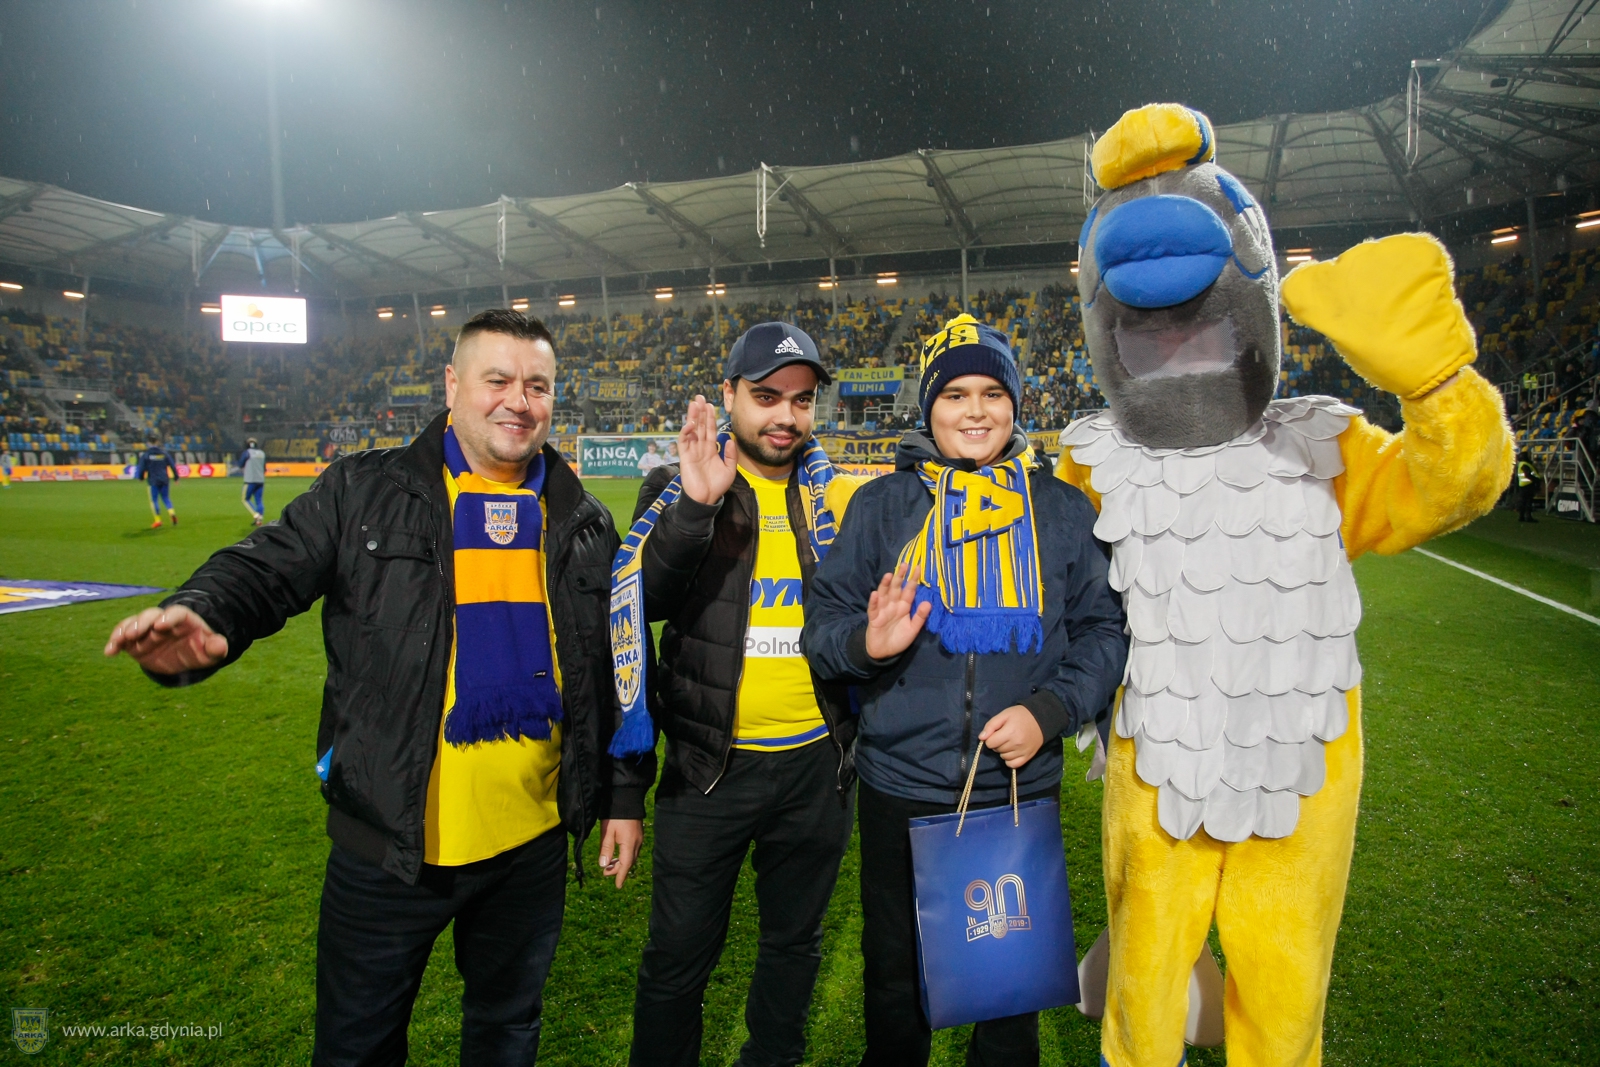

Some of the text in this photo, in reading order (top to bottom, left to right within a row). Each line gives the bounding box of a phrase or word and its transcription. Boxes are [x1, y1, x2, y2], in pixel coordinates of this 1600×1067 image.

[233, 321, 297, 335] opec
[775, 346, 804, 356] adidas
[600, 381, 628, 389] POWIAT
[852, 384, 885, 392] RUMIA
[597, 387, 627, 398] PUCKI
[843, 442, 897, 455] ARKA
[583, 447, 639, 461] KINGA
[587, 459, 634, 468] PIENIŃSKA
